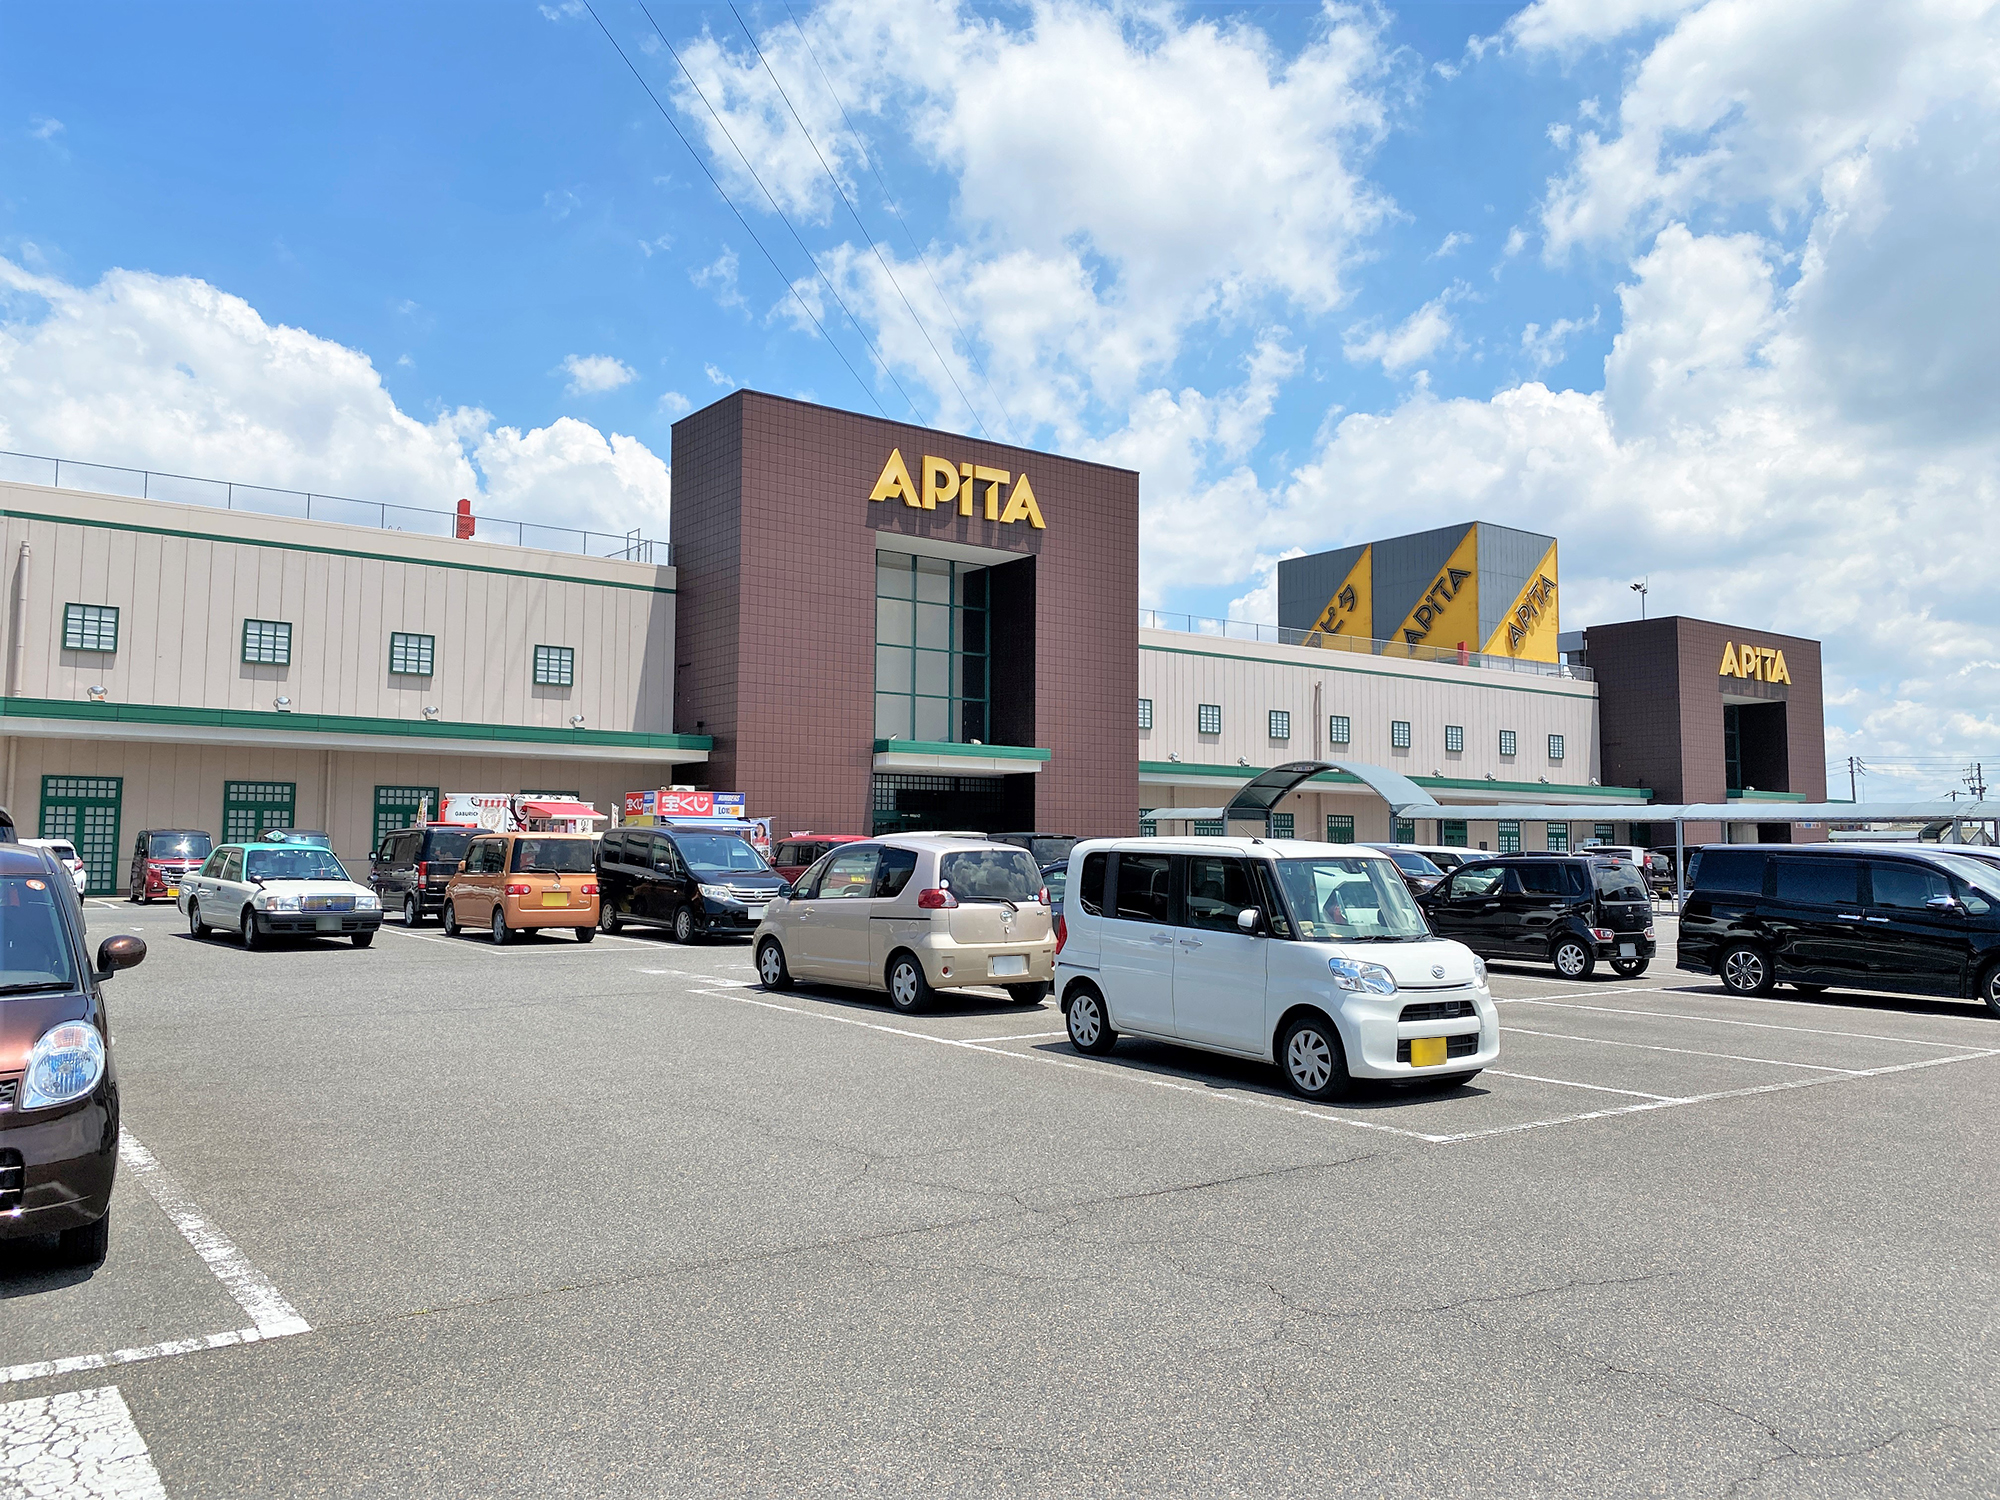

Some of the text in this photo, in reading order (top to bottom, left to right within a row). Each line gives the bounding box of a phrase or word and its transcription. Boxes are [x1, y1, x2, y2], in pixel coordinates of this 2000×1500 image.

[626, 798, 643, 811] 宝くじ
[661, 796, 710, 813] 宝くじ
